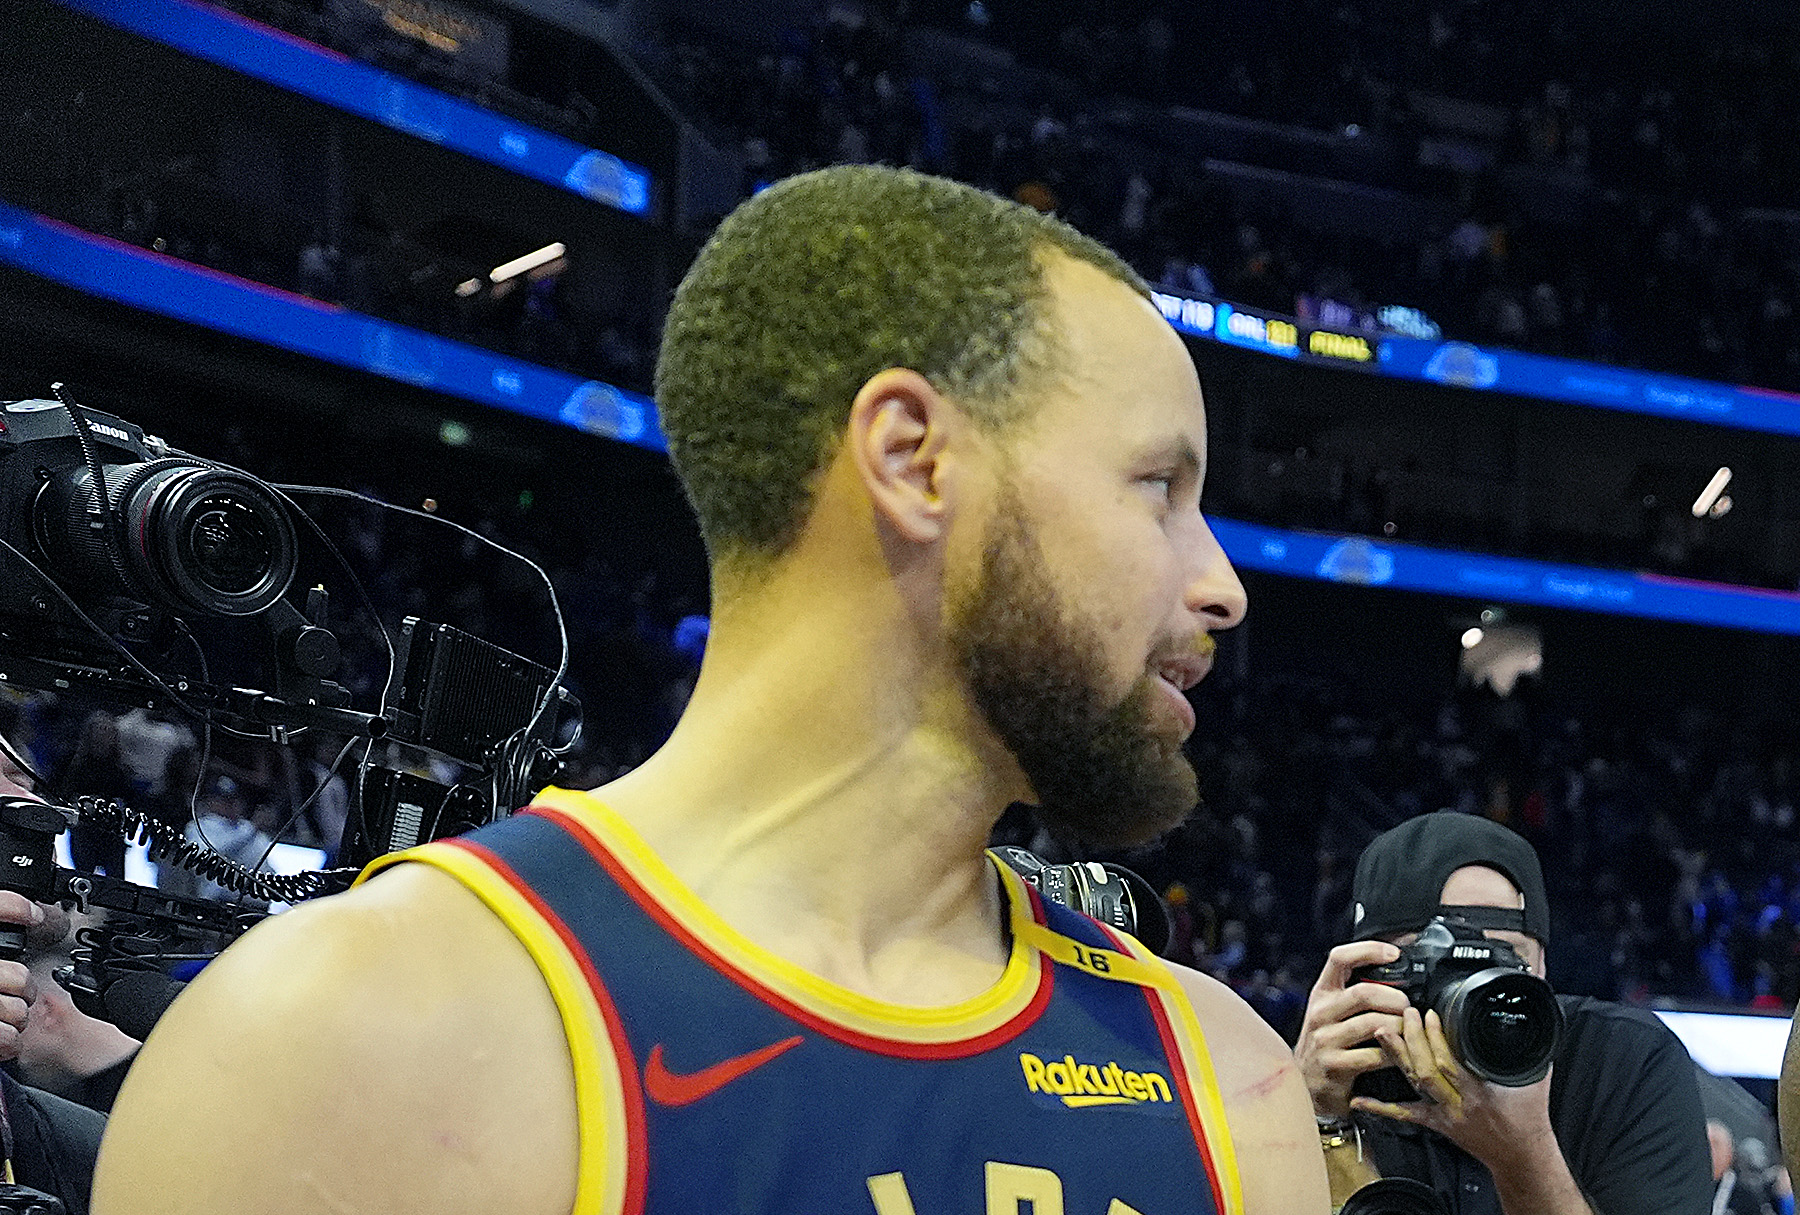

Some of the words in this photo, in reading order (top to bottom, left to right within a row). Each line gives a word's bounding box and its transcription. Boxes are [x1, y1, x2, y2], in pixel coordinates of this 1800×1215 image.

[84, 418, 129, 441] anon
[12, 855, 33, 867] dji
[1073, 945, 1111, 973] 16
[1453, 946, 1490, 959] Nikon
[1020, 1053, 1173, 1105] Rakuten
